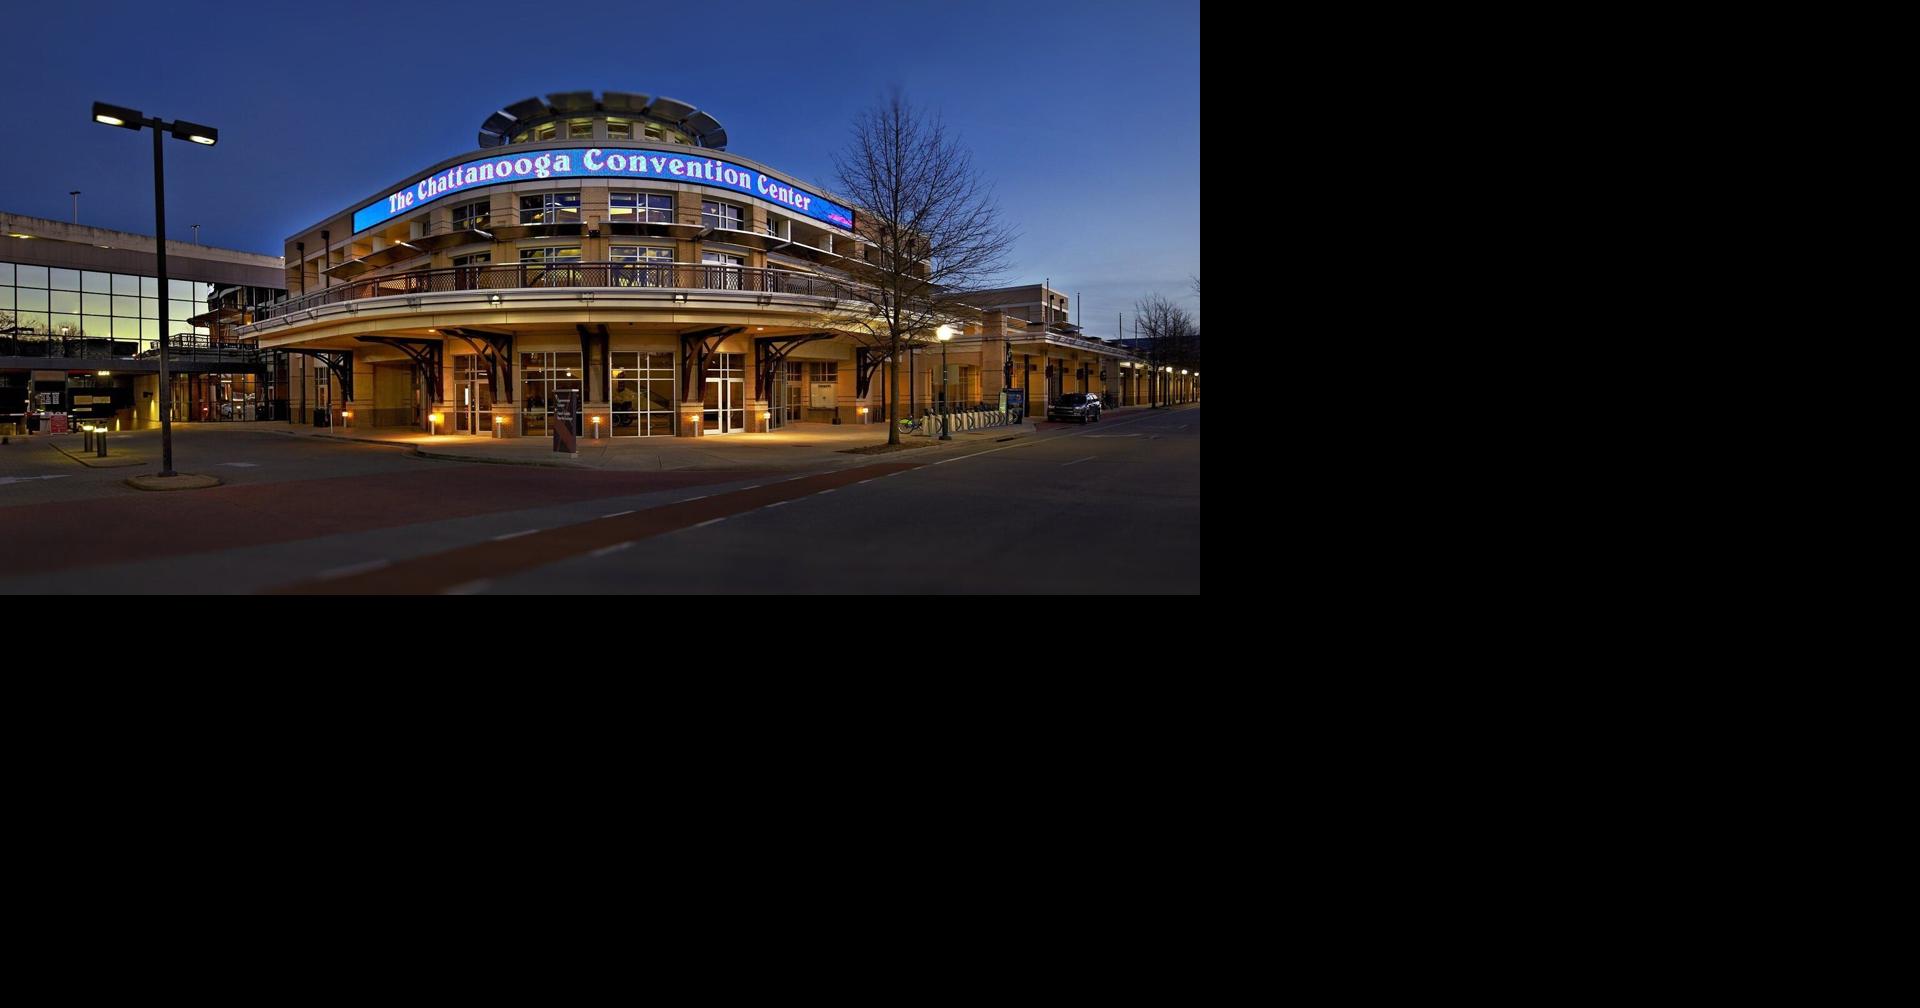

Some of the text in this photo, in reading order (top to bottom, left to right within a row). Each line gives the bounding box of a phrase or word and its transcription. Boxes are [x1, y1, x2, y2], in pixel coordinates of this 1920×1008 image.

[388, 148, 812, 214] The Chattanooga Convention Center
